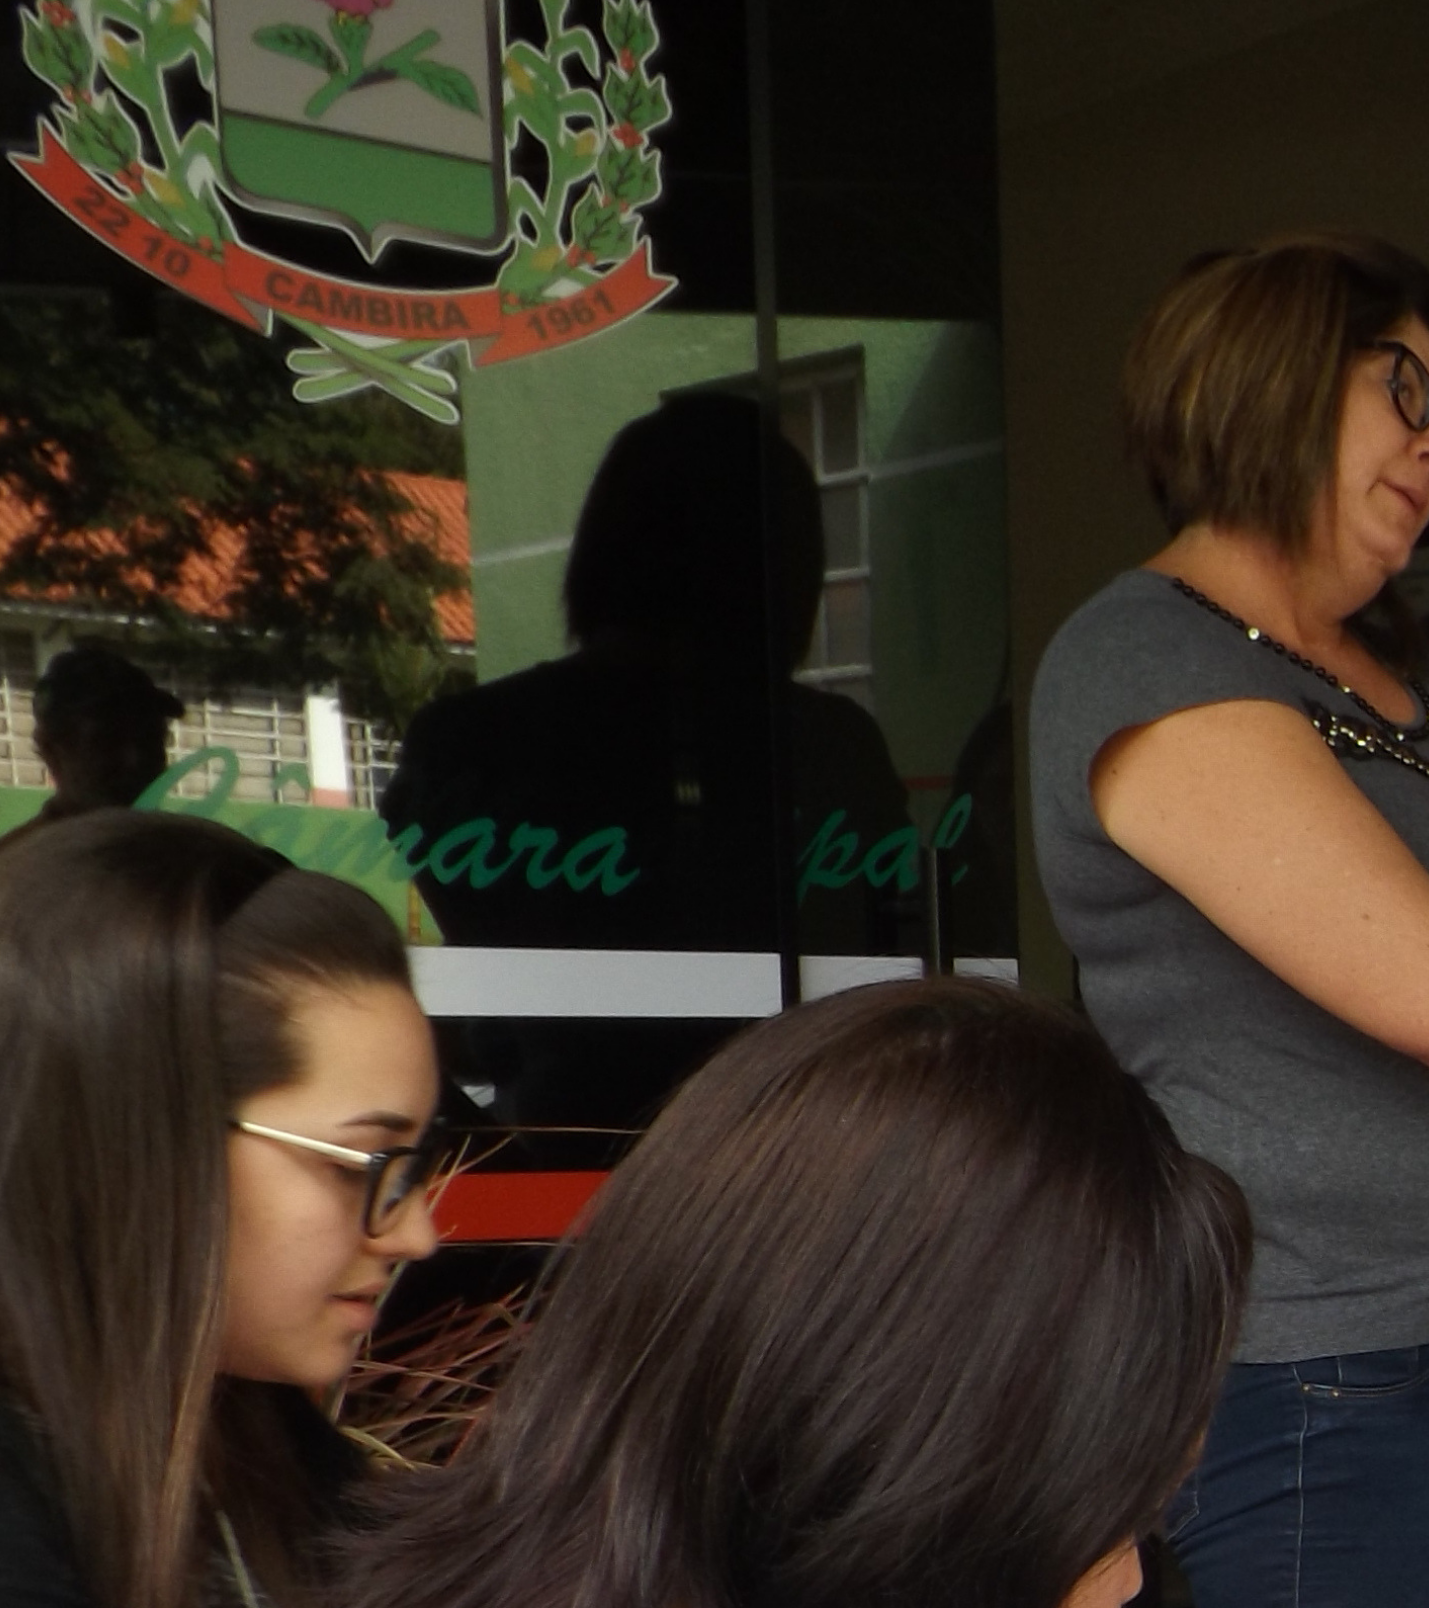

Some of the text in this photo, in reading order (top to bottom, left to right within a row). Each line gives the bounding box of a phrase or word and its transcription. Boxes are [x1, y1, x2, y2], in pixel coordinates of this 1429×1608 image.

[73, 184, 190, 277] 22 10
[264, 270, 469, 331] CAMBIRA
[526, 290, 616, 340] 1961
